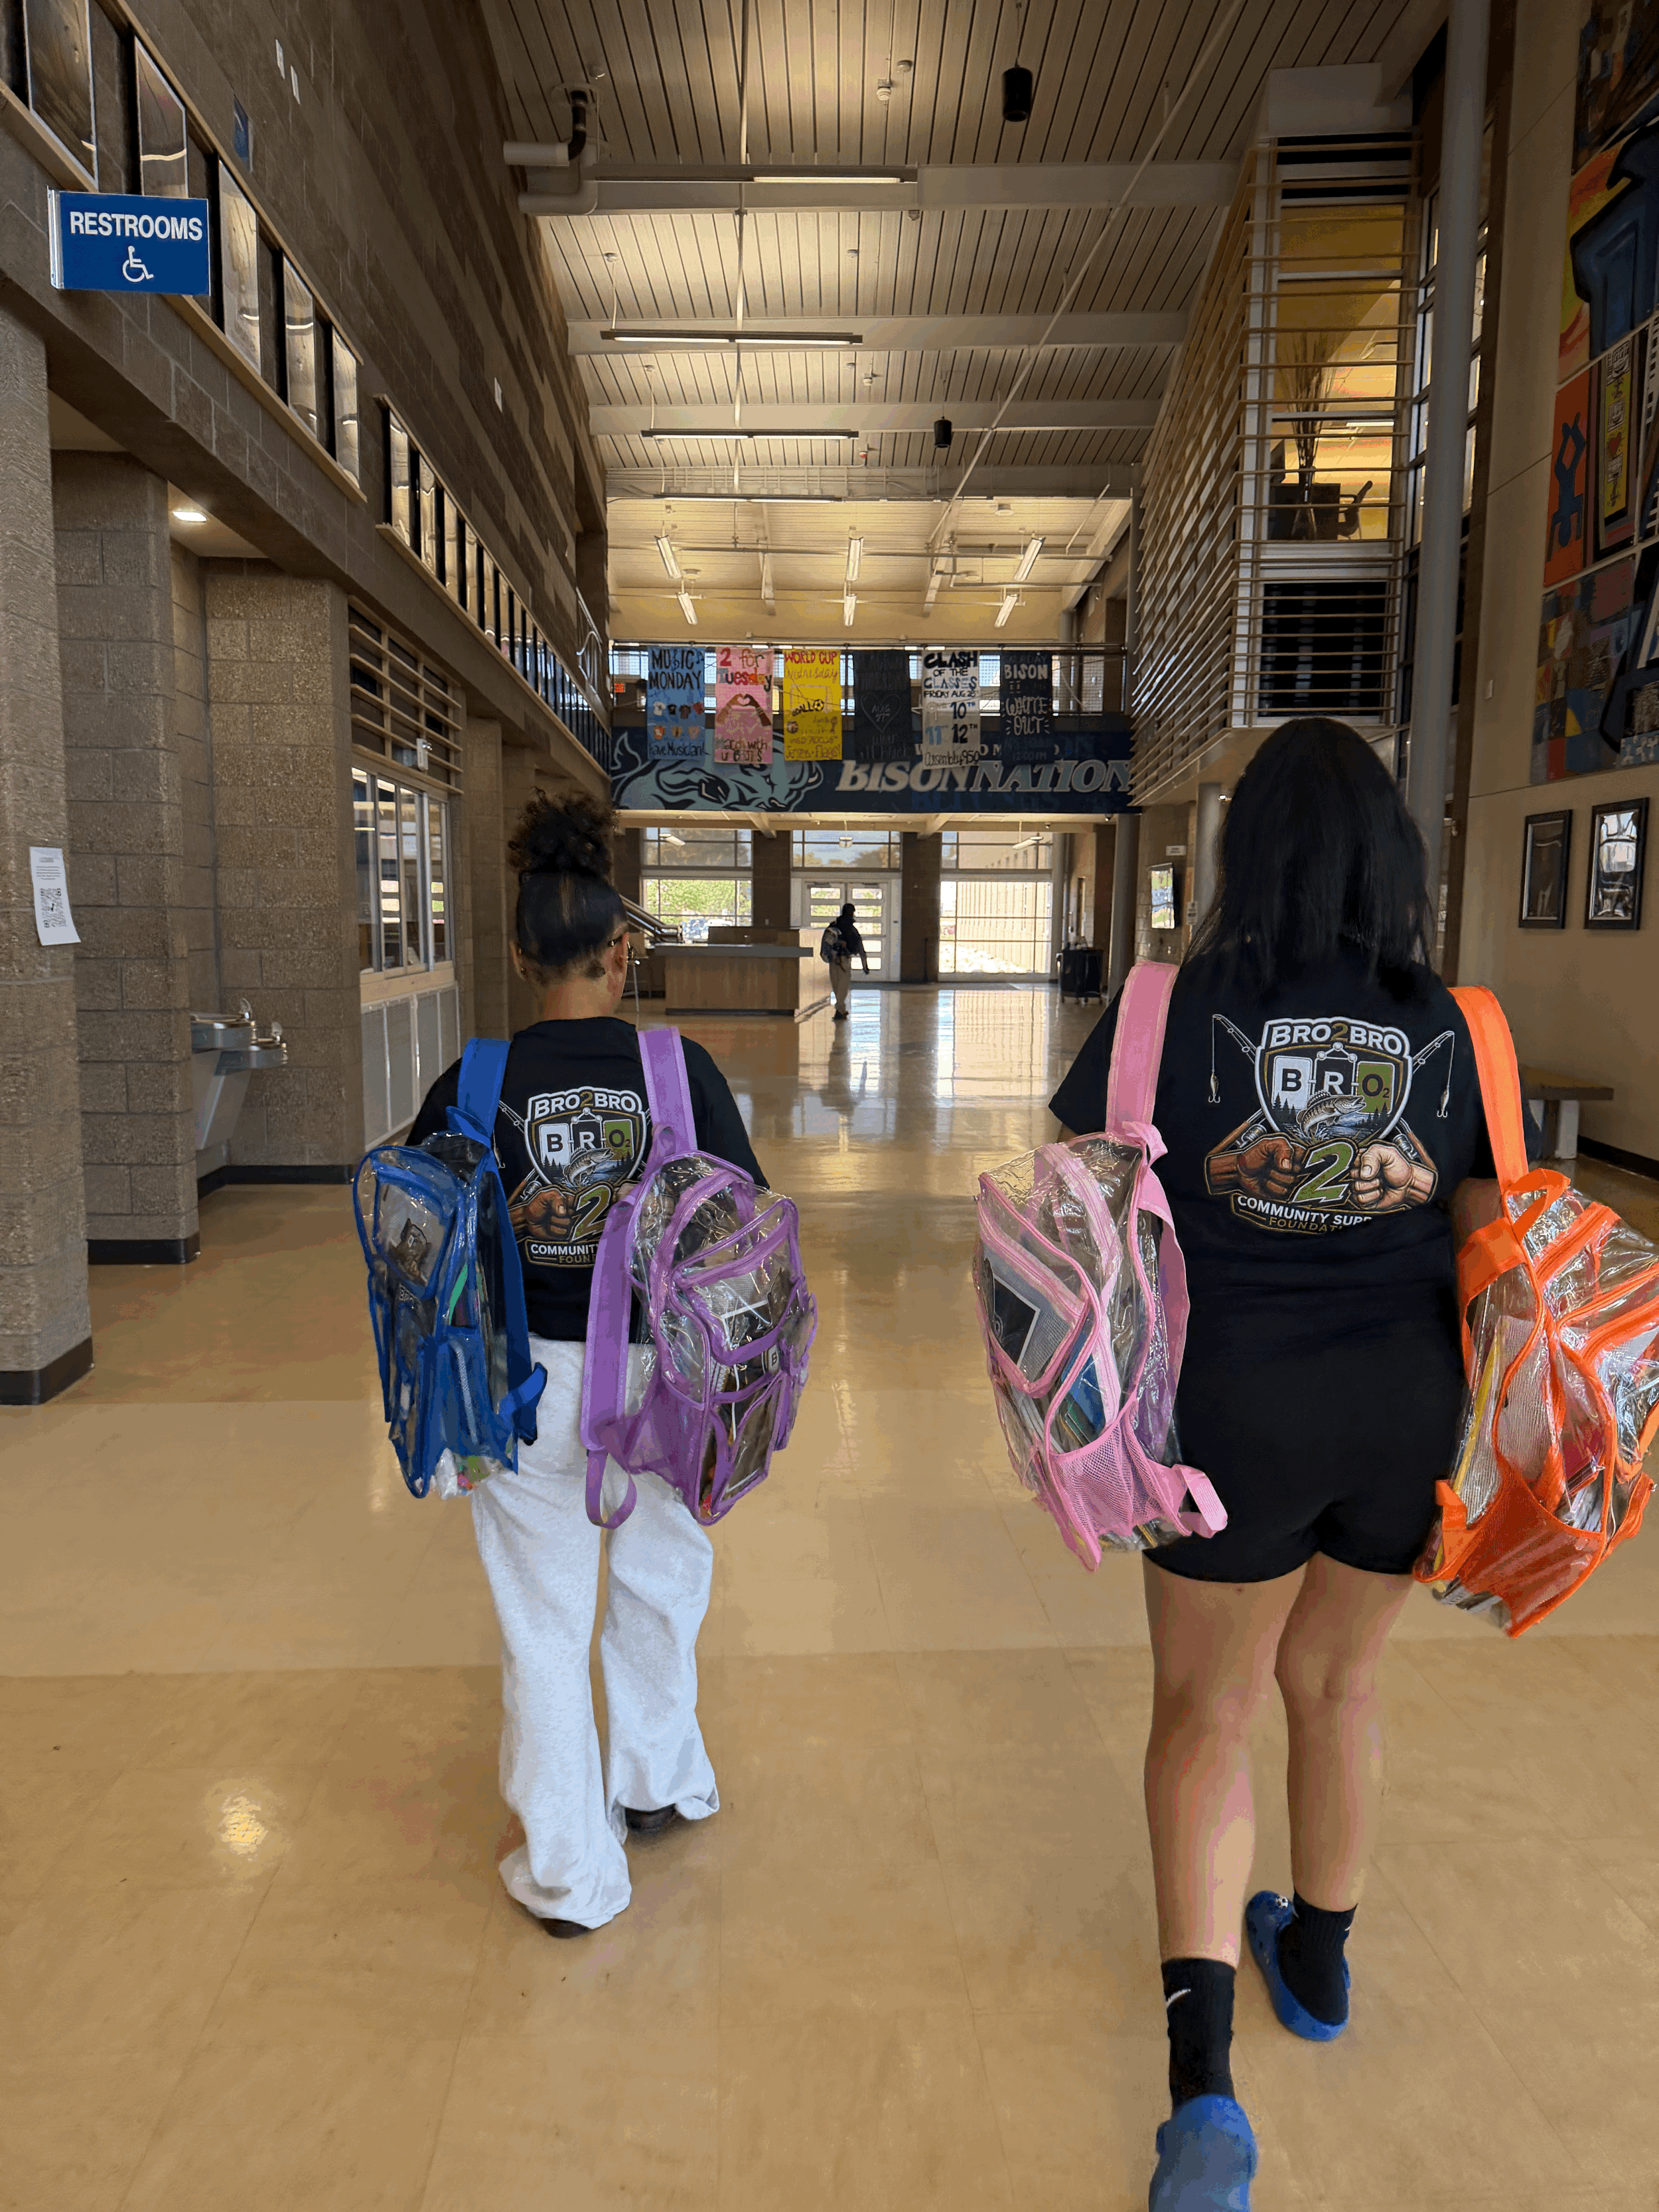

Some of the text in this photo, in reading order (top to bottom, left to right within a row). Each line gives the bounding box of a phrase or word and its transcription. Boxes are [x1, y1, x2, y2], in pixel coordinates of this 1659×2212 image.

[70, 211, 203, 241] RESTROOMS
[720, 648, 764, 668] 2 for
[784, 651, 837, 664] WORLD CUP
[924, 651, 977, 669] CLASH
[649, 670, 701, 690] MONDAY
[717, 668, 772, 692] Tuesday
[1004, 664, 1048, 680] BISON
[923, 676, 977, 690] CLASSES
[952, 723, 977, 744] 12TH
[1013, 716, 1045, 736] OUT
[1269, 1023, 1402, 1055] BRO2BRO
[1281, 1068, 1303, 1092] B
[1324, 1071, 1344, 1094] R
[534, 1091, 637, 1119] BRO2BRO
[546, 1134, 563, 1153] B
[579, 1132, 595, 1149] R
[1292, 1142, 1355, 1203] 2
[572, 1185, 611, 1241] 2
[1237, 1195, 1331, 1223] COMMUNITY
[531, 1244, 598, 1255] COMMUNIT
